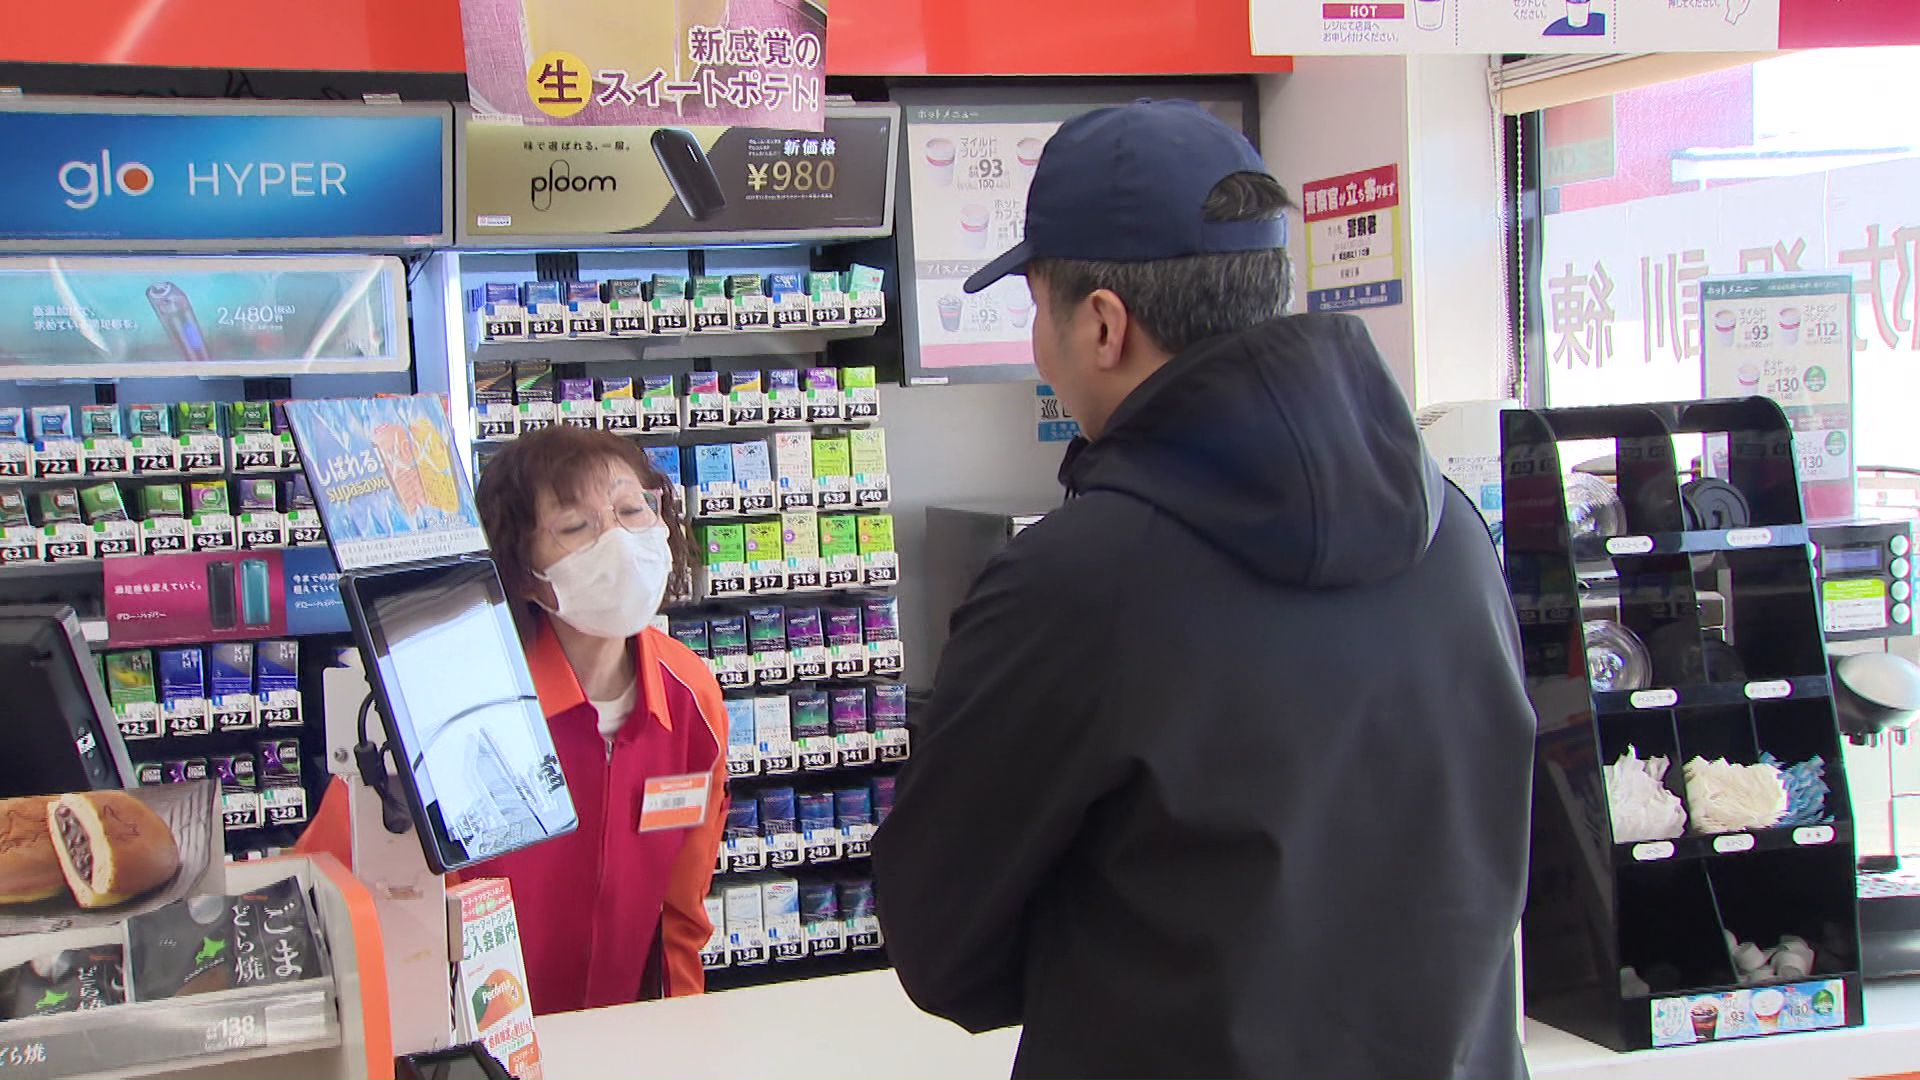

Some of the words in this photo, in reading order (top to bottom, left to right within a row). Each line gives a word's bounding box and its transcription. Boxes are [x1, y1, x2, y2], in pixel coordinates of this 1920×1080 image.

[1350, 5, 1378, 18] HOT
[1323, 21, 1380, 32] レジにて店員へ
[689, 26, 821, 68] 新感覚の
[537, 59, 583, 105] 生
[918, 109, 979, 118] ホットメニュー
[783, 137, 836, 157] 新価格
[59, 149, 154, 209] glo
[188, 162, 348, 196] HYPER
[746, 160, 836, 192] ¥980
[978, 159, 1003, 178] 93
[530, 159, 617, 212] ploom
[491, 323, 514, 334] 811
[533, 322, 558, 332] 812
[573, 321, 598, 331] 813
[615, 319, 639, 329] 814
[657, 317, 681, 327] 815
[698, 316, 722, 326] 816
[739, 313, 763, 323] 817
[778, 311, 801, 322] 818
[815, 309, 839, 320] 819
[853, 307, 877, 318] 820
[1751, 325, 1769, 341] 93
[1775, 377, 1800, 393] 130
[482, 423, 506, 433] 731
[606, 416, 631, 427] 734
[647, 415, 672, 426] 735
[696, 410, 719, 420] 736
[734, 408, 757, 419] 737
[773, 407, 796, 417] 738
[812, 405, 835, 416] 739
[849, 404, 872, 415] 740
[39, 461, 71, 472] 722
[90, 458, 121, 469] 723
[138, 456, 169, 467] 724
[185, 455, 213, 466] 725
[242, 453, 269, 464] 726
[705, 499, 730, 510] 636
[743, 497, 767, 508] 637
[784, 494, 808, 505] 638
[823, 492, 847, 503] 639
[859, 490, 882, 501] 640
[2, 548, 30, 560] 621
[51, 544, 80, 555] 622
[100, 541, 129, 552] 623
[151, 536, 179, 549] 624
[197, 535, 224, 545] 625
[246, 532, 275, 543] 626
[294, 529, 321, 541] 627
[714, 579, 738, 590] 516
[754, 576, 777, 588] 517
[792, 573, 815, 585] 518
[829, 571, 852, 582] 519
[867, 569, 890, 580] 520
[719, 672, 743, 683] 438
[759, 669, 783, 680] 439
[796, 664, 819, 674] 440
[835, 661, 857, 672] 441
[873, 657, 897, 667] 442
[120, 723, 149, 734] 425
[169, 718, 198, 729] 426
[219, 713, 247, 725] 427
[264, 709, 292, 720] 428
[765, 758, 788, 770] 339
[802, 754, 825, 765] 340
[841, 750, 864, 761] 341
[271, 808, 297, 819] 328
[732, 855, 756, 866] 238
[770, 851, 794, 863] 239
[807, 847, 831, 858] 240
[845, 842, 868, 853] 241
[230, 904, 267, 984] どら焼
[263, 899, 303, 978] ごま
[735, 950, 758, 961] 138
[775, 944, 798, 956] 139
[812, 939, 835, 950] 140
[851, 935, 872, 946] 141
